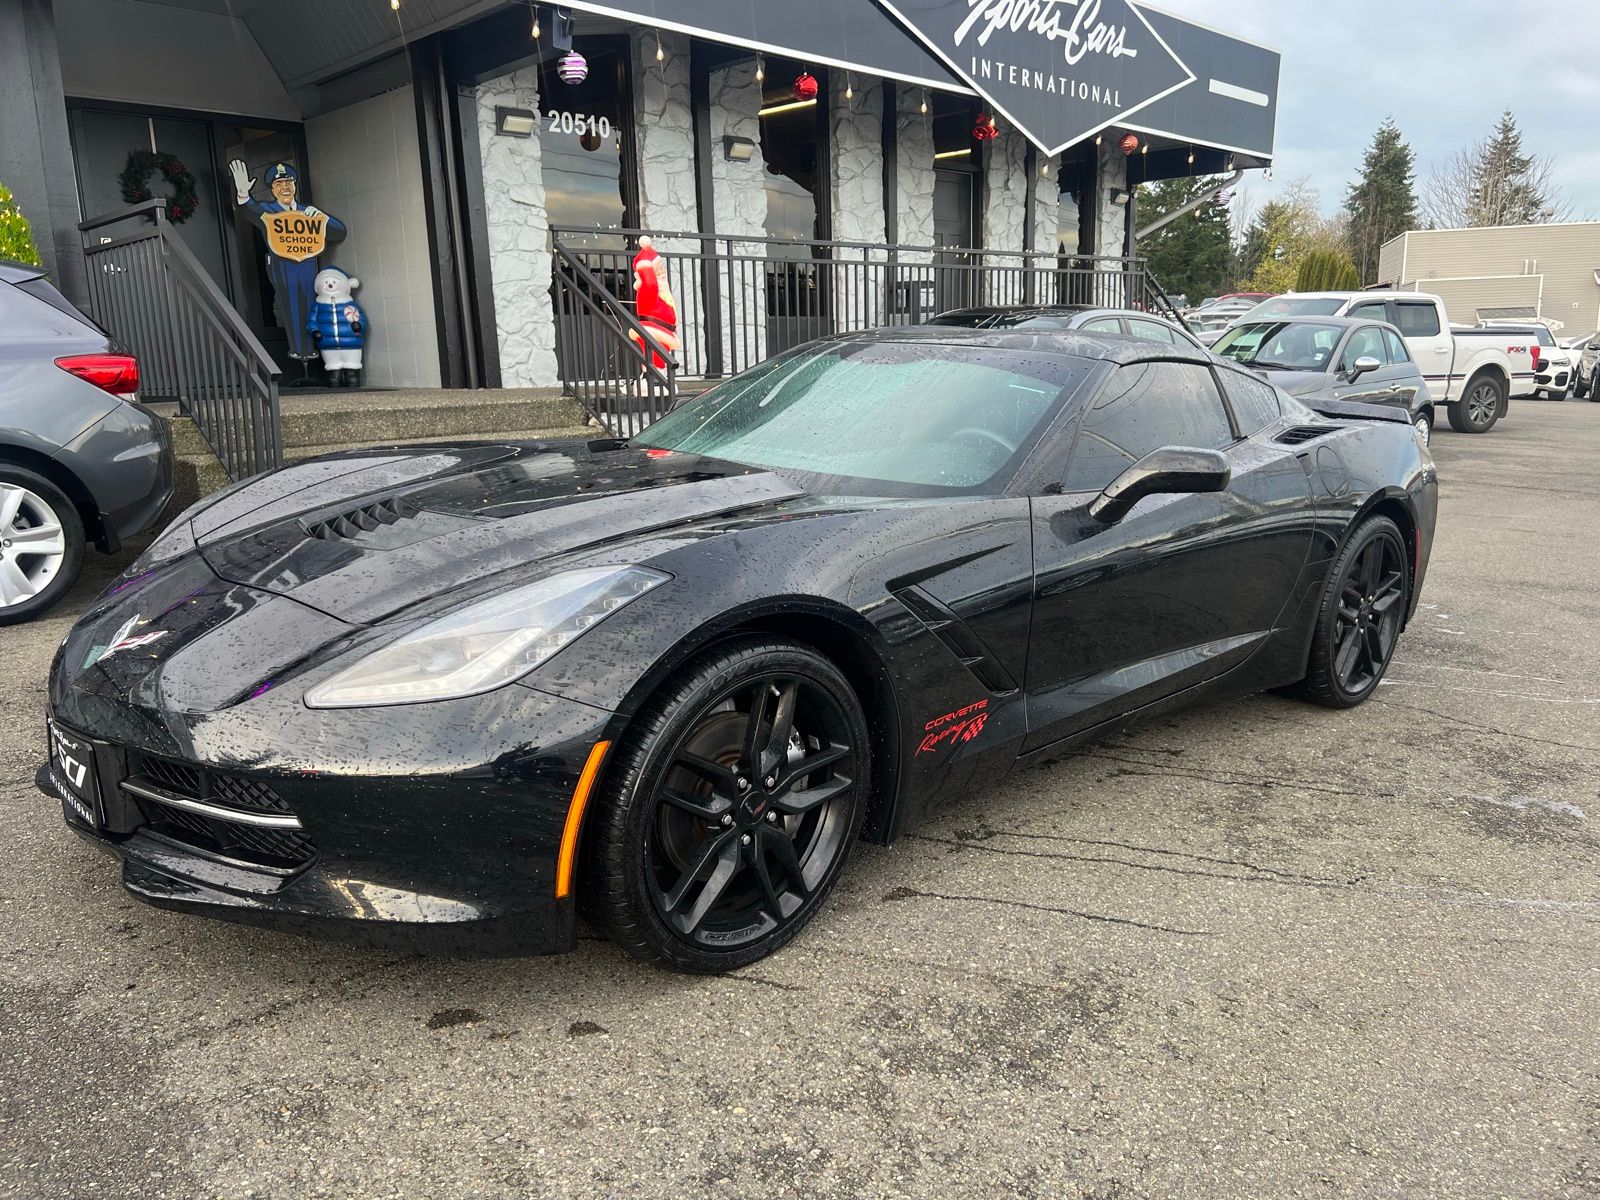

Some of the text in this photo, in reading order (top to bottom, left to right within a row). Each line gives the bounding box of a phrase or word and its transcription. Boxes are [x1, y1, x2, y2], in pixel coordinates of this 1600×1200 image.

[971, 56, 1121, 108] INTERNATIONAL
[547, 109, 611, 139] 20510
[273, 218, 322, 235] SLOW
[279, 235, 320, 244] SCHOOL
[286, 245, 314, 254] ZONE
[1506, 345, 1527, 354] FX4
[924, 699, 989, 731] CORVETTE
[914, 712, 987, 757] Racing
